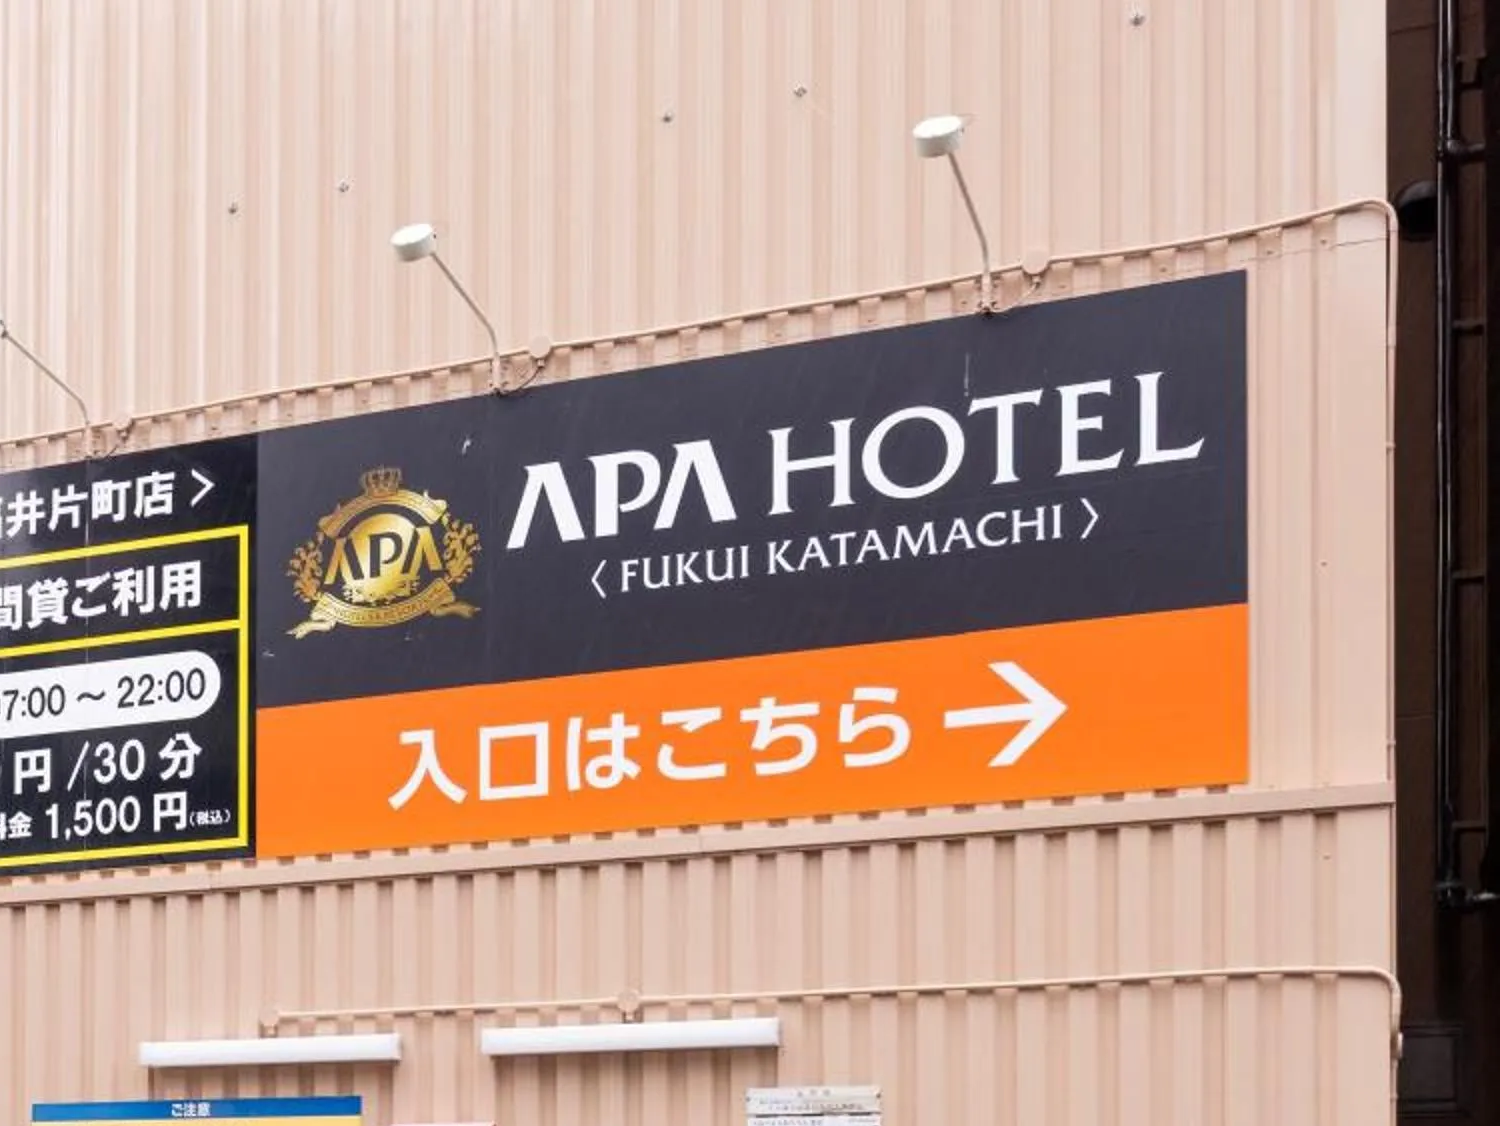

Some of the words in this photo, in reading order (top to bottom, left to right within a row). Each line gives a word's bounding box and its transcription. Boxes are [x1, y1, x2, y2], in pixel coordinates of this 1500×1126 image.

[508, 441, 738, 550] APA
[770, 371, 1206, 517] HOTEL
[322, 522, 446, 586] APA
[388, 686, 912, 810] 入口はこちら
[171, 1102, 211, 1118] ご注意
